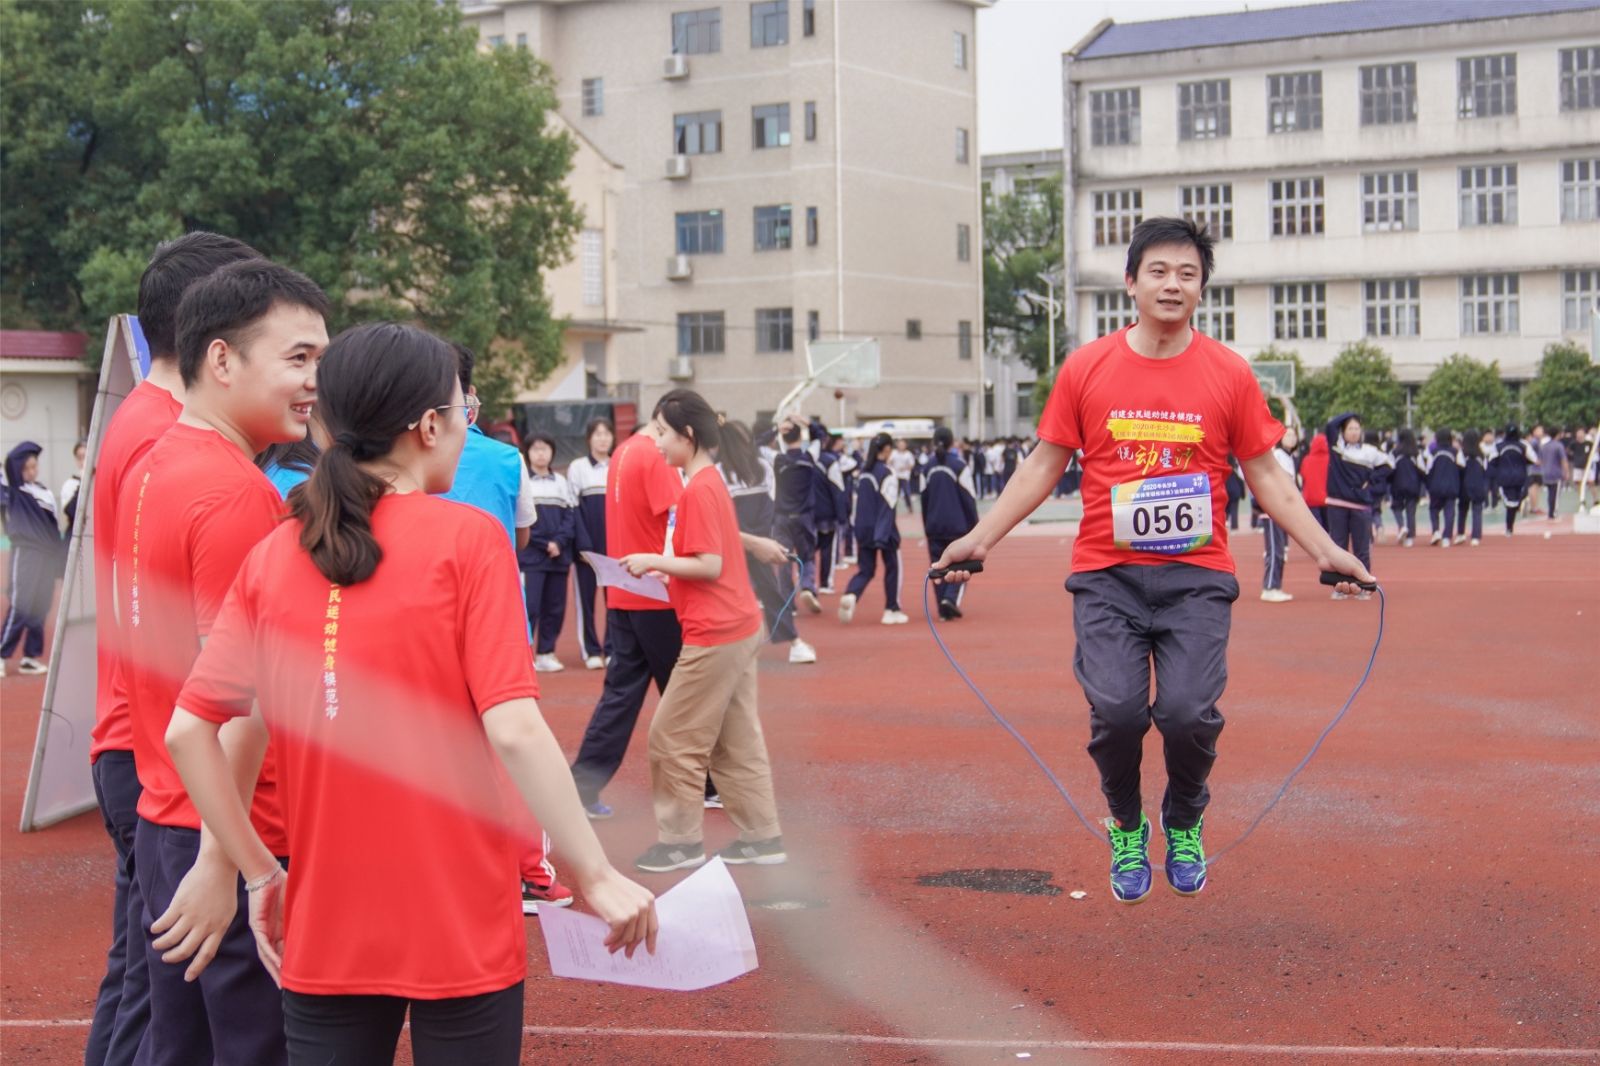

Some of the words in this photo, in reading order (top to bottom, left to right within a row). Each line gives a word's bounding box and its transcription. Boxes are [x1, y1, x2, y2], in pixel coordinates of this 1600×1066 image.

[1110, 409, 1203, 423] 创建全民运动健身模范市
[1117, 442, 1194, 475] 悦动星沙
[1133, 503, 1194, 536] 056
[323, 584, 341, 720] 民运动健身模范市
